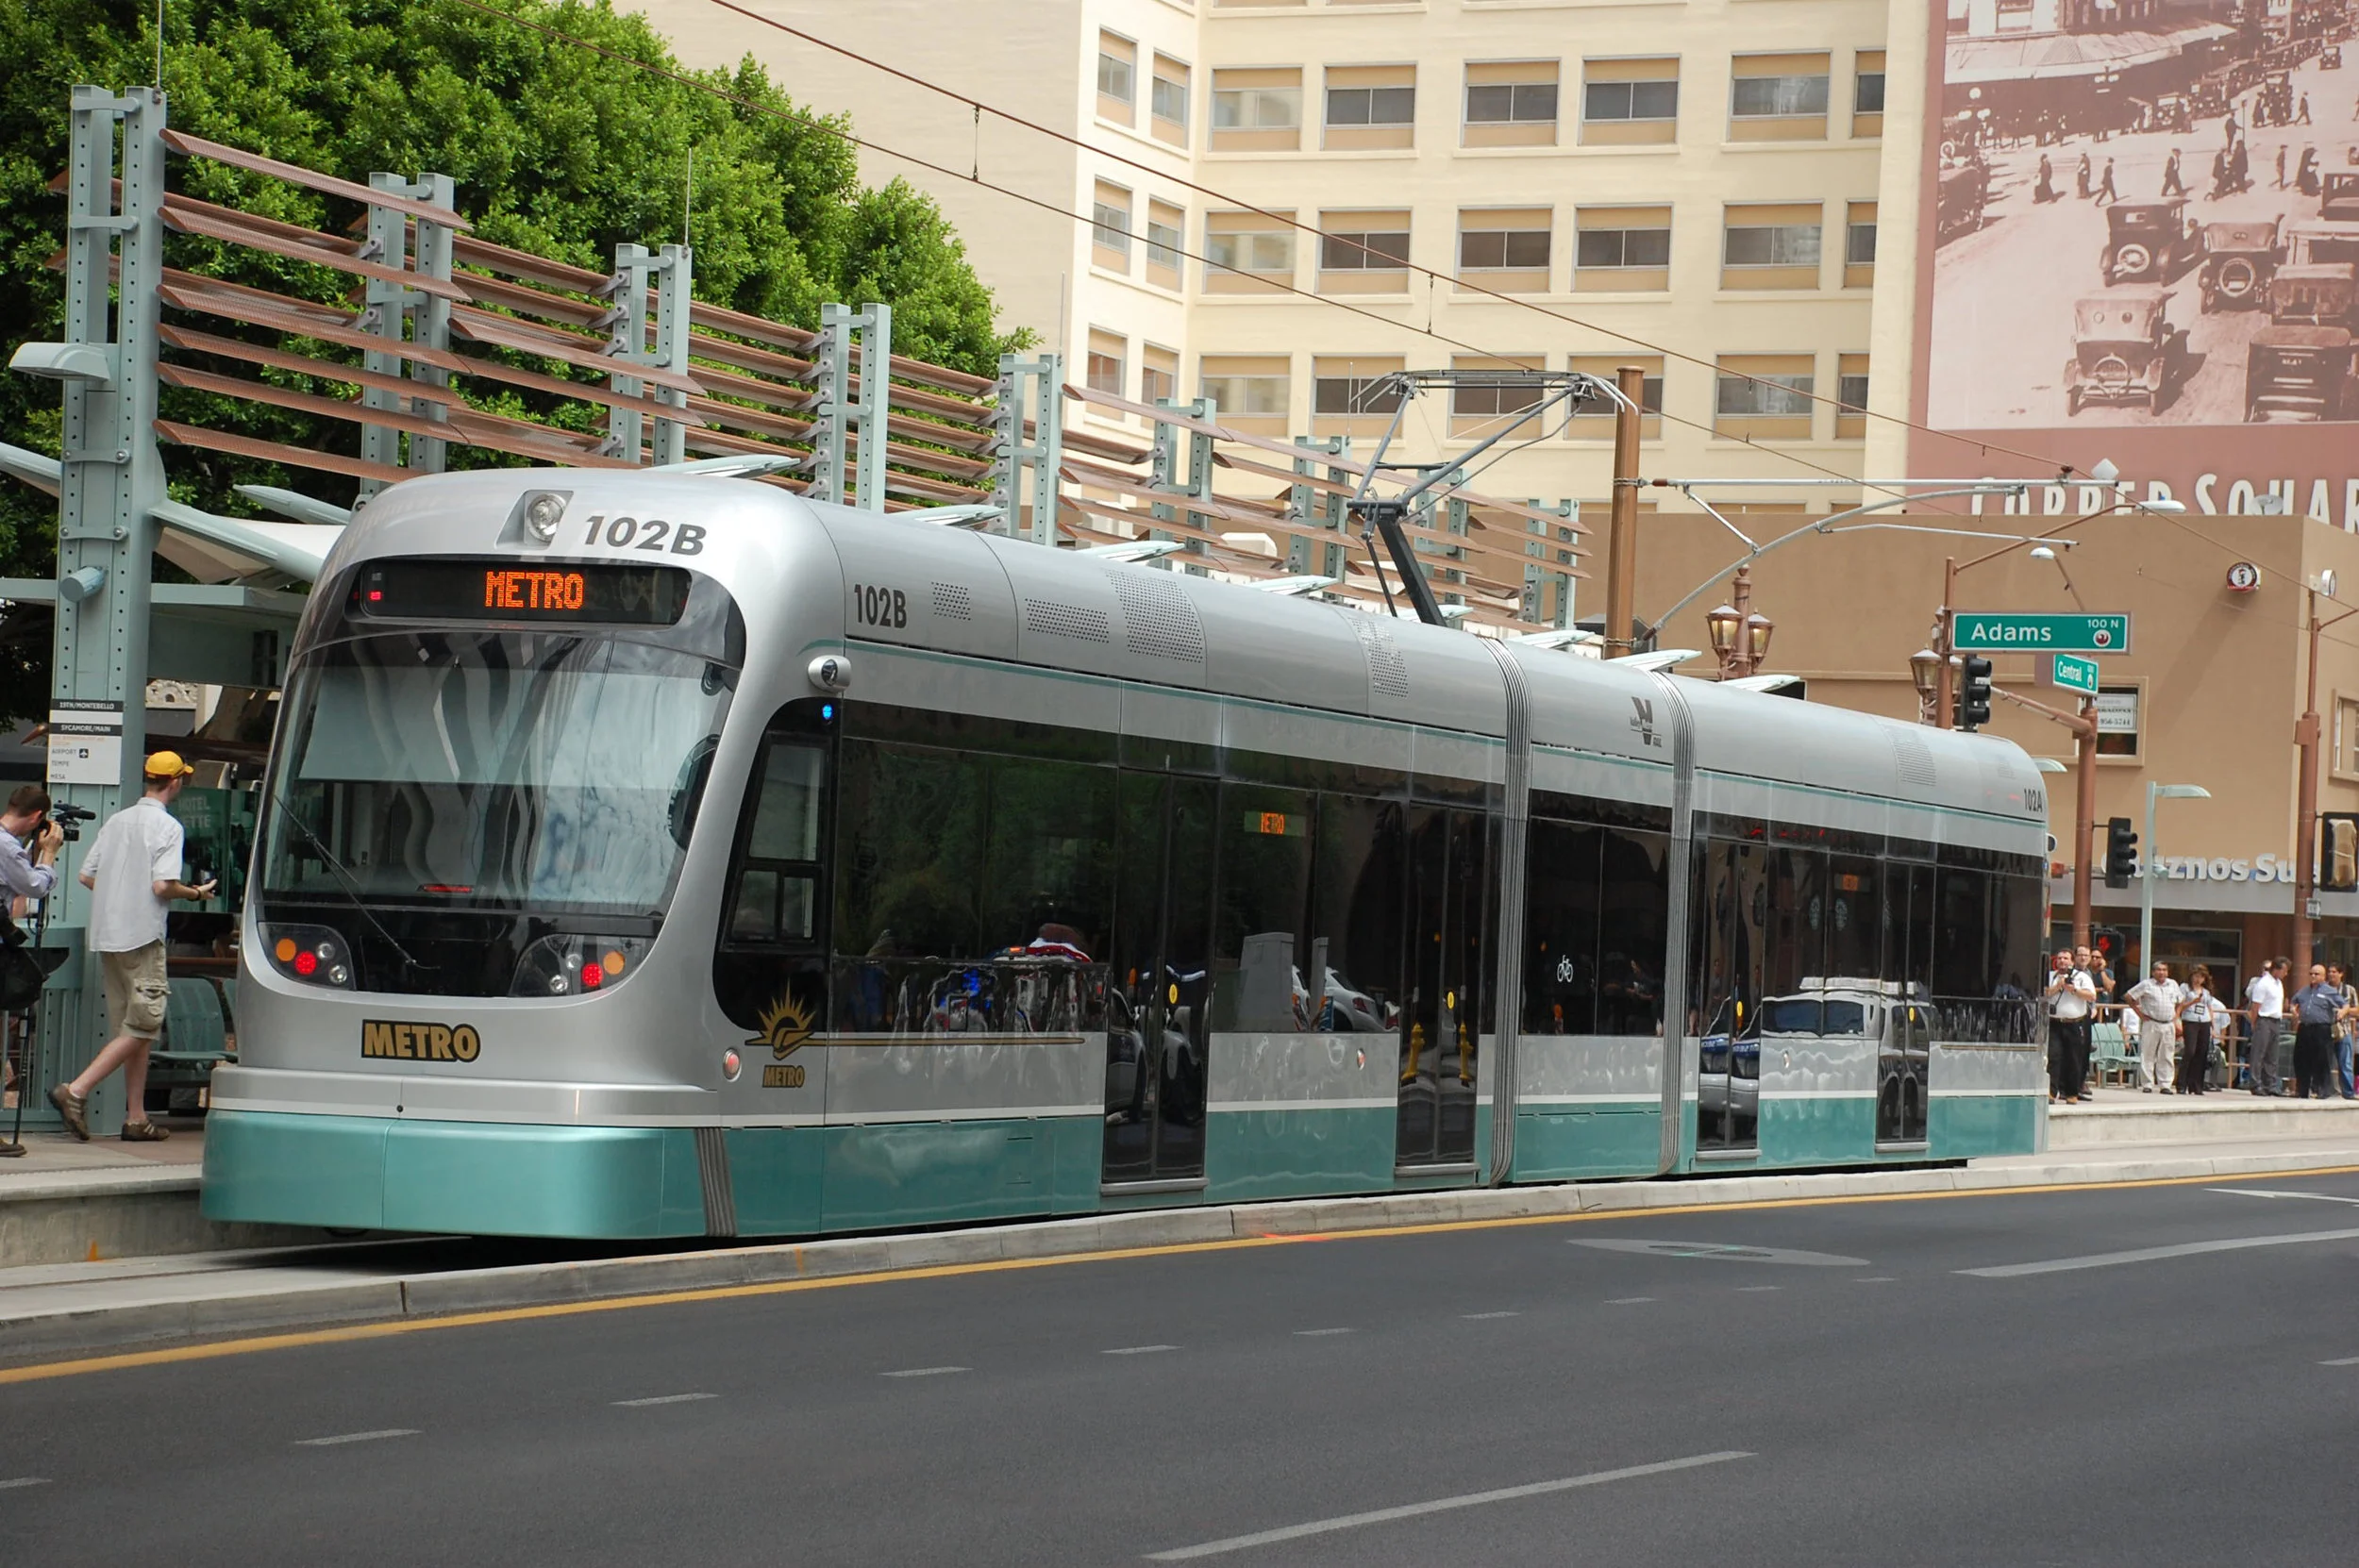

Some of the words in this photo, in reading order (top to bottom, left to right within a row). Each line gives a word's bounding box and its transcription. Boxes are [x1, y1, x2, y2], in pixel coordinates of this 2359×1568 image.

[585, 515, 707, 556] 102B
[484, 571, 584, 609] METRO
[854, 583, 907, 628] 102B
[1970, 623, 2052, 642] Adams
[2087, 619, 2107, 628] 100
[2111, 619, 2119, 628] N
[2057, 660, 2083, 682] Central
[2023, 788, 2043, 812] 102A
[362, 1021, 479, 1060] METRO
[762, 1065, 805, 1087] METRO
